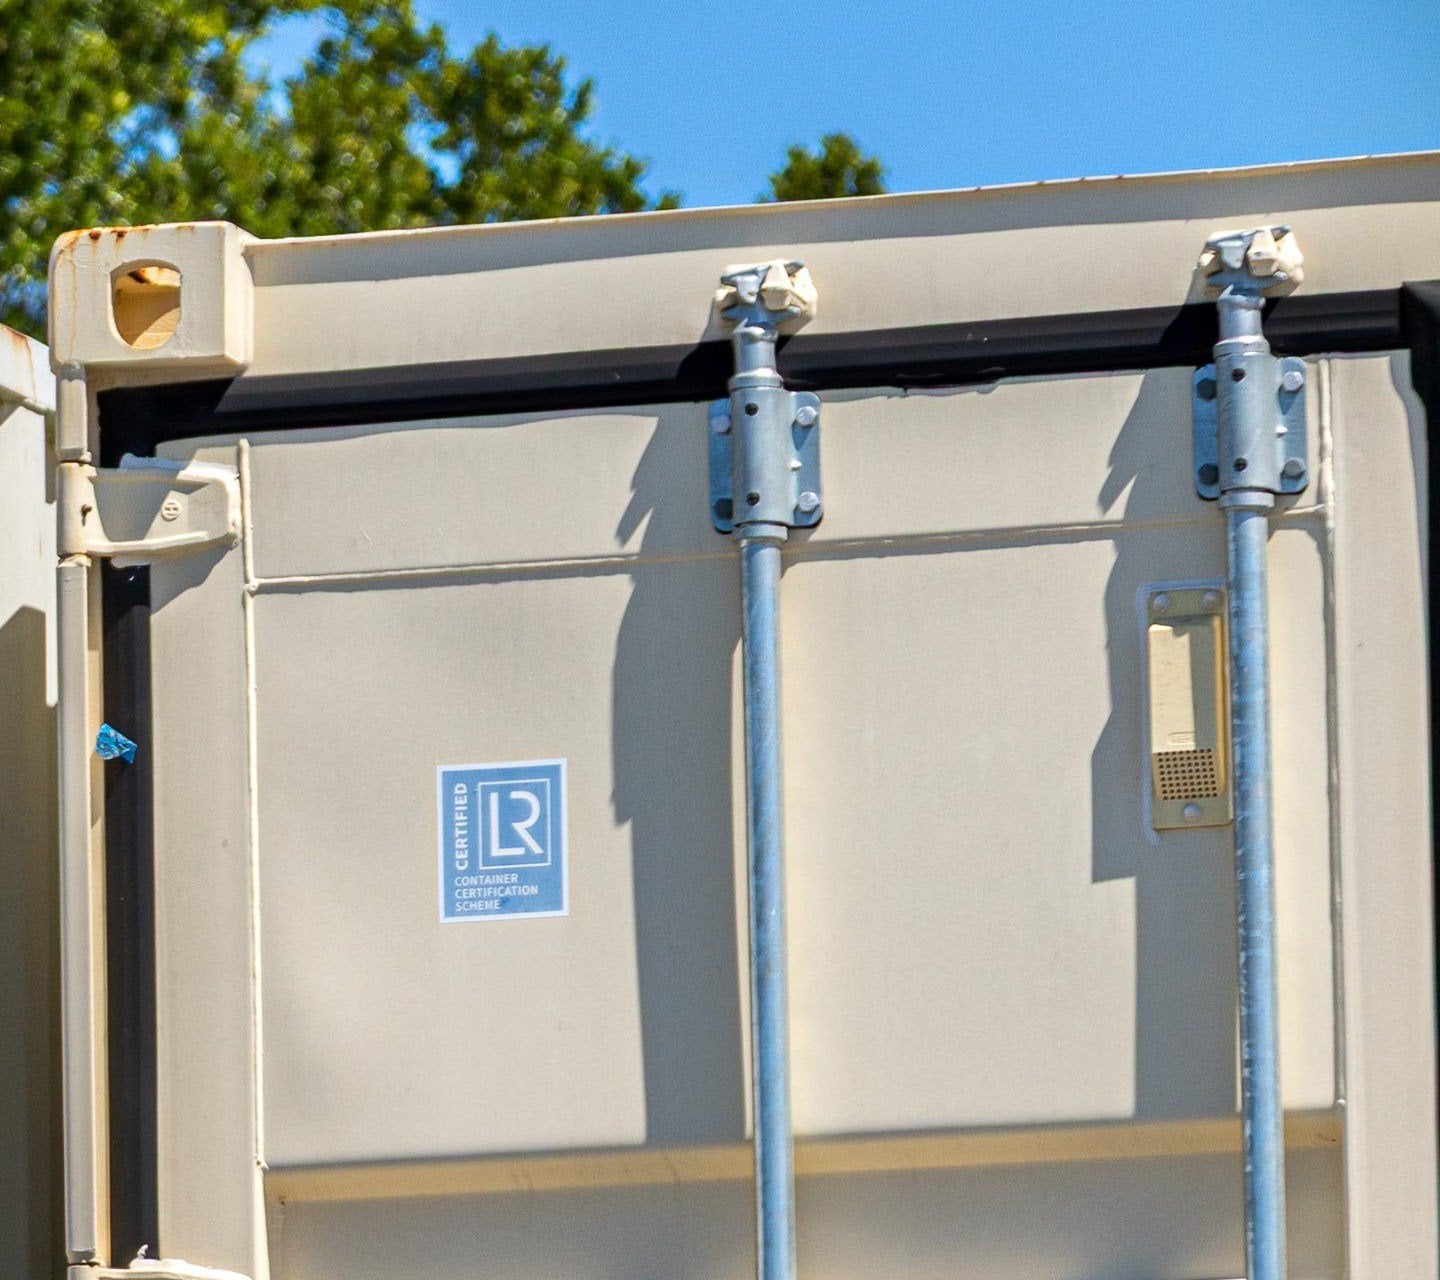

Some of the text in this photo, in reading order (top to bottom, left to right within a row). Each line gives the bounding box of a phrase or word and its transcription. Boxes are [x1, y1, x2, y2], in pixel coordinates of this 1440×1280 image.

[455, 783, 468, 870] CERTIFIED
[489, 790, 545, 857] LR
[455, 873, 519, 887] CONTAINER
[455, 885, 539, 898] CERTIFICATION
[456, 899, 501, 912] SCHEME
